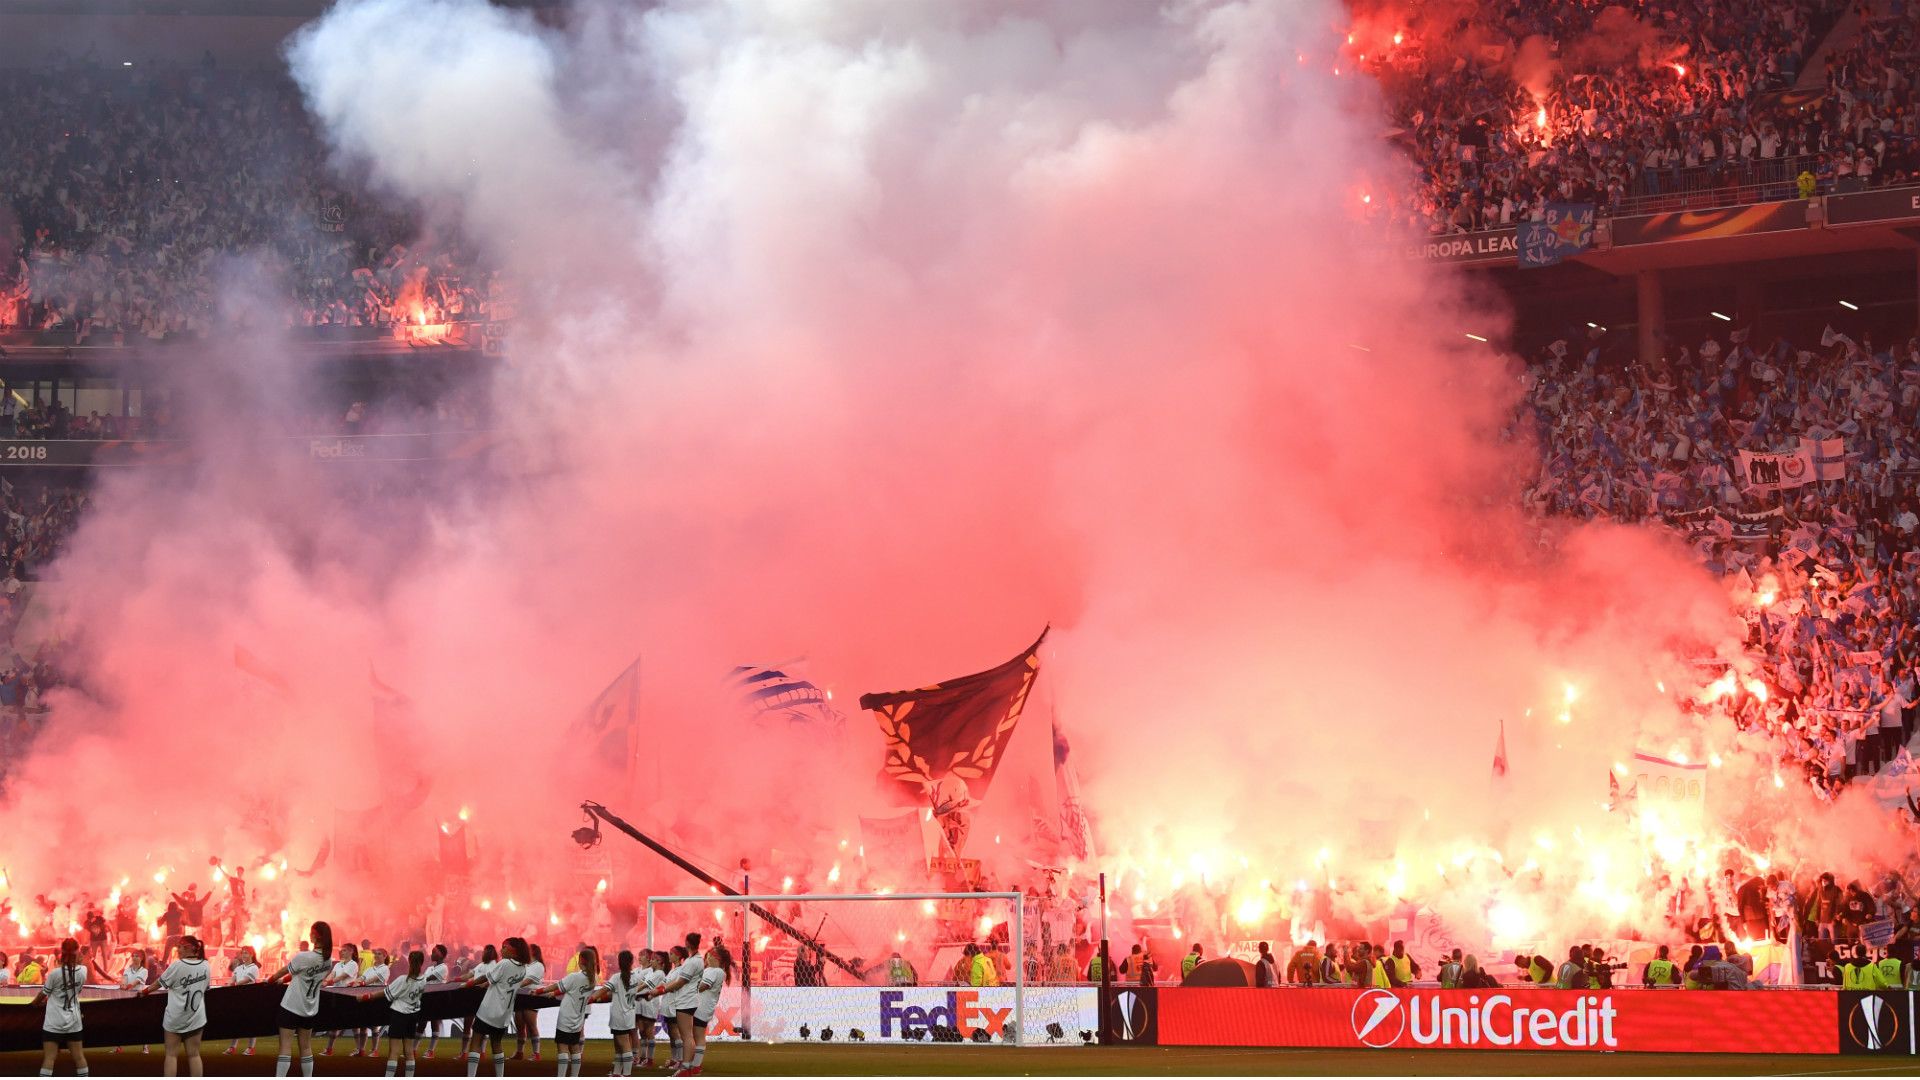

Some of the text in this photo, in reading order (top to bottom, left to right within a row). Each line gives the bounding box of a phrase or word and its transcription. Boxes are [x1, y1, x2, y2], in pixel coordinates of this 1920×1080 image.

[7, 446, 47, 459] 2018
[310, 440, 365, 458] FedEx
[1235, 941, 1259, 953] NAB
[880, 991, 1013, 1038] FedEx
[1410, 995, 1617, 1046] UniCredit
